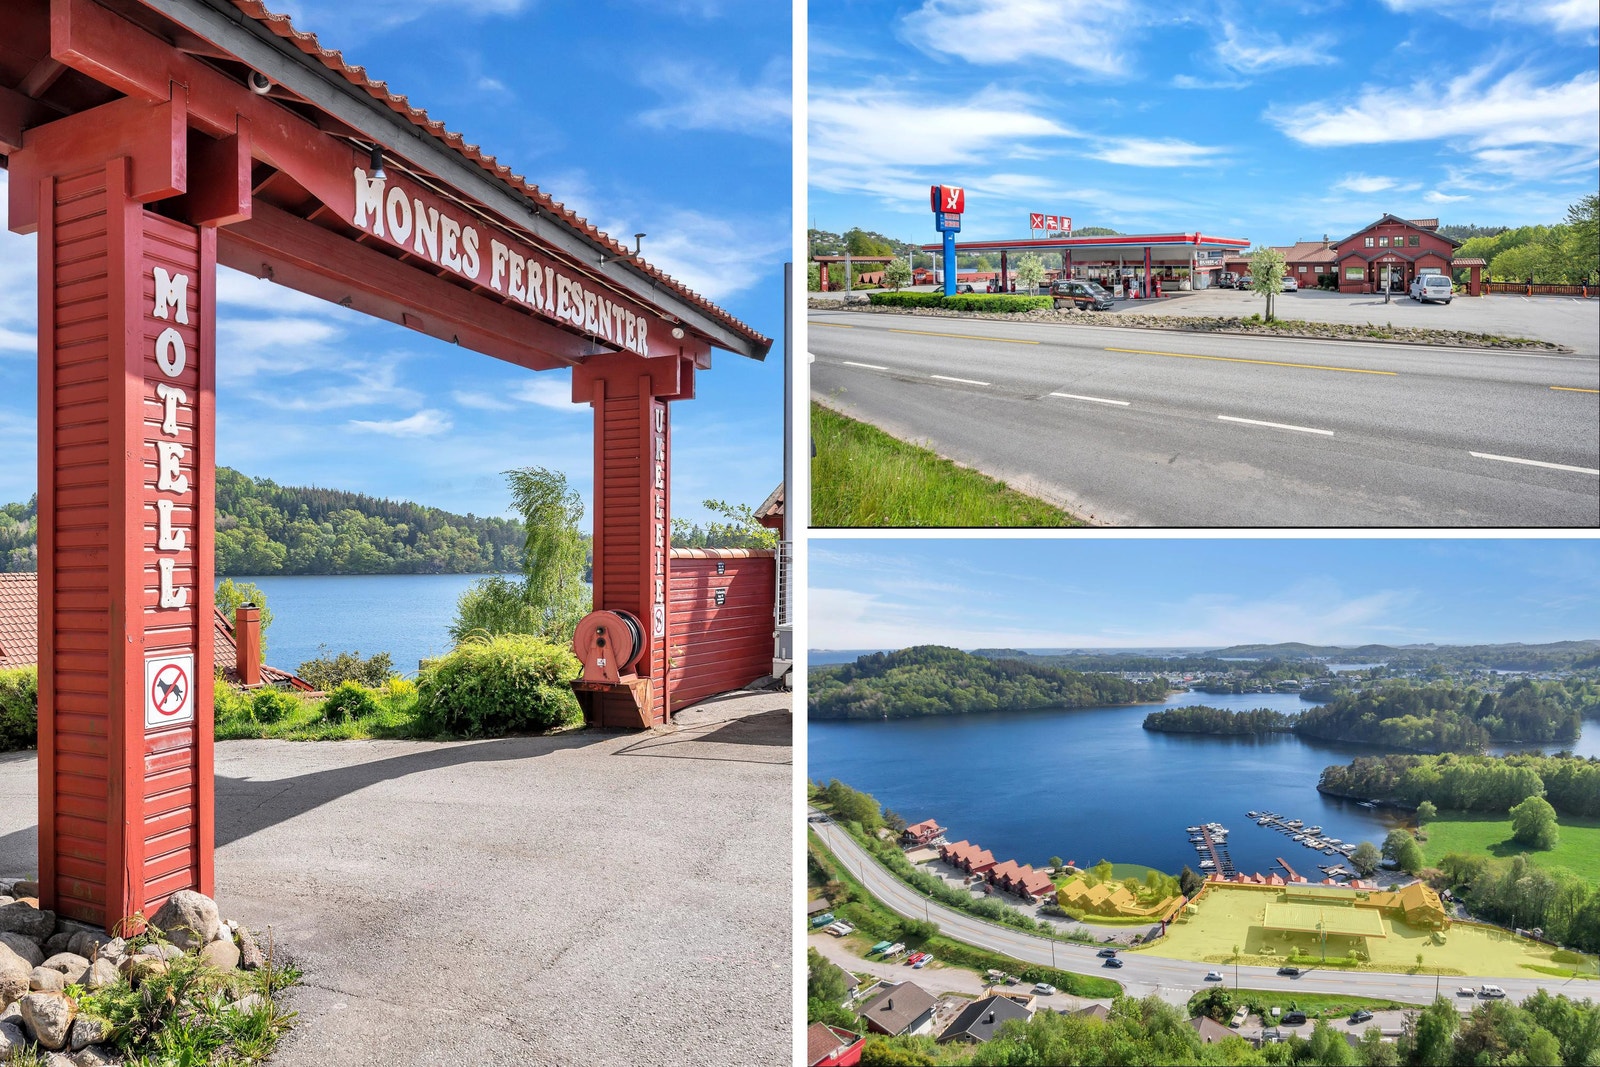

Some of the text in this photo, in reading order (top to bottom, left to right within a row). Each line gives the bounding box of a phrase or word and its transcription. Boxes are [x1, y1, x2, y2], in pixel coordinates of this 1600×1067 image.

[353, 166, 649, 358] MONES FERIESENTER
[152, 266, 190, 609] MOTELL
